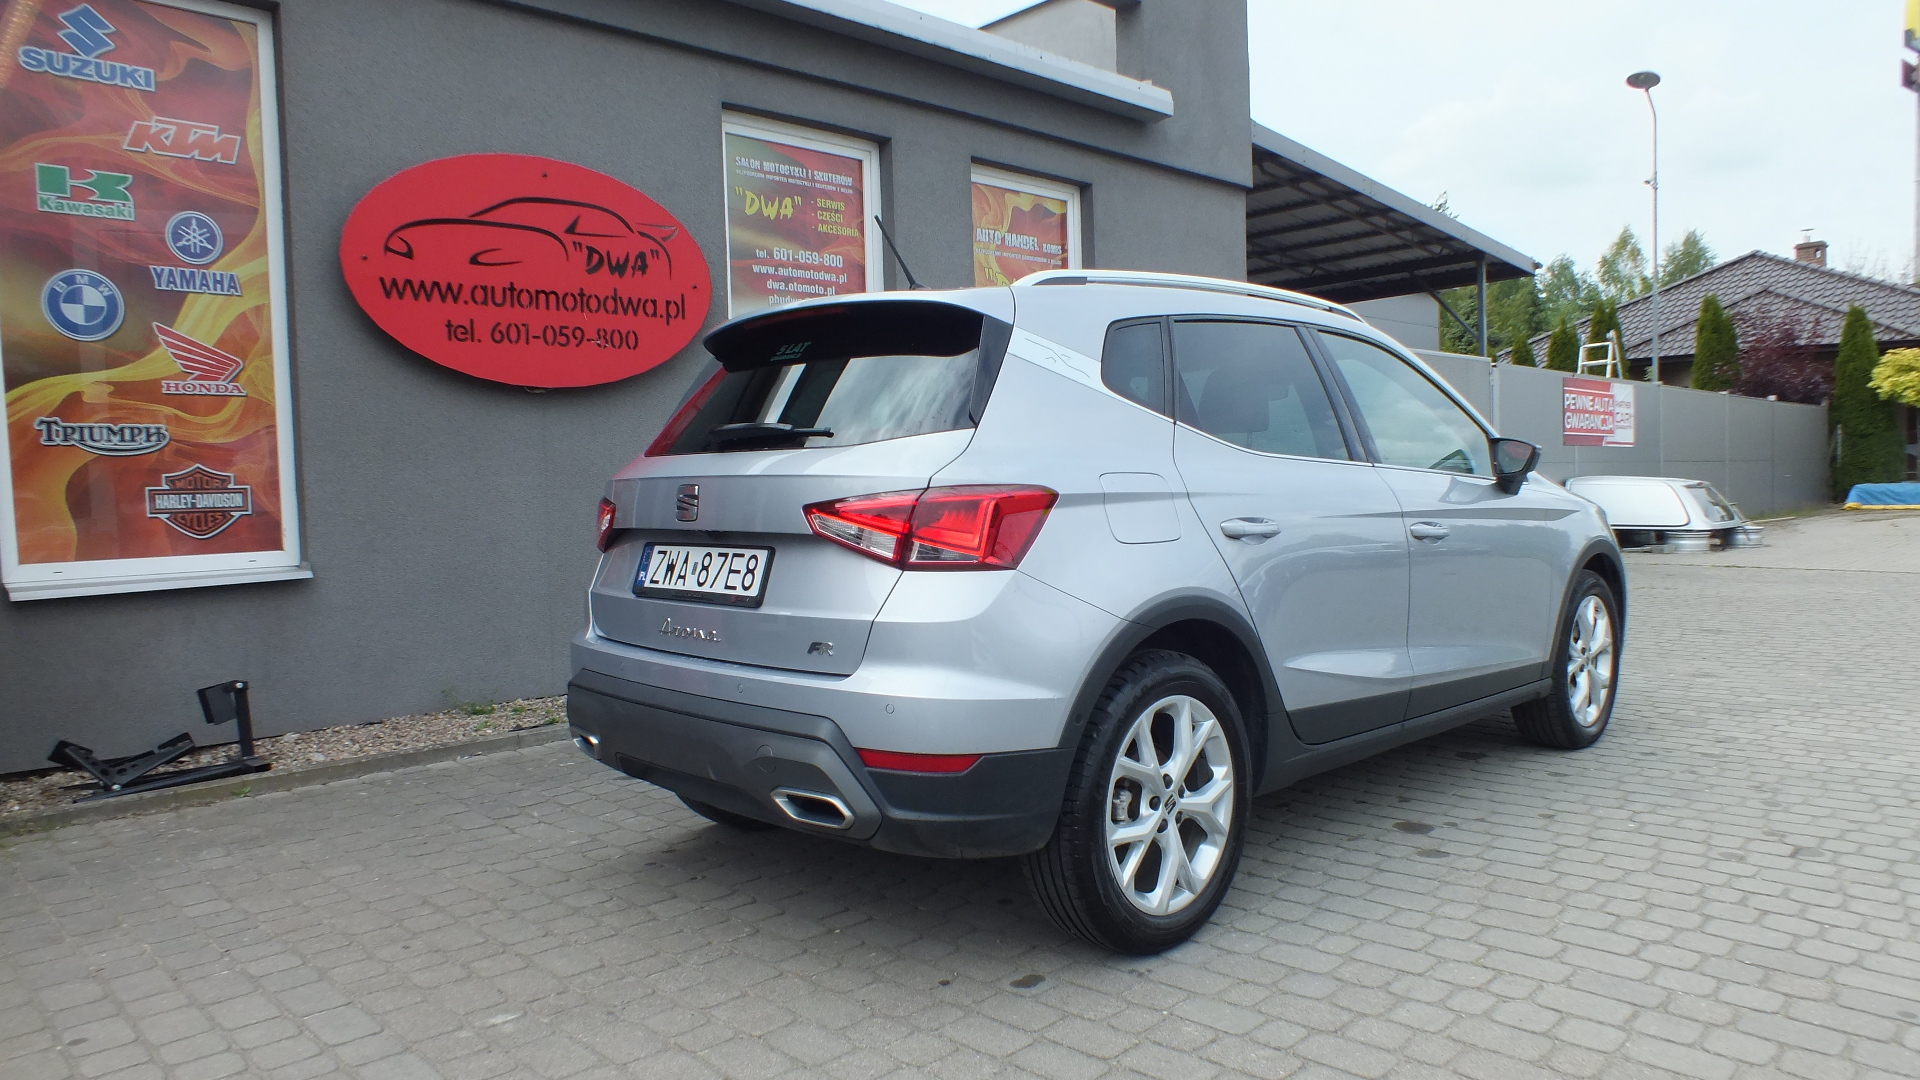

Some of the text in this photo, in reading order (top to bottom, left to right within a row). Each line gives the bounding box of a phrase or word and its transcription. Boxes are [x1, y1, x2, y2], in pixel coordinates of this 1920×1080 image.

[18, 46, 155, 92] SUZUKI
[123, 116, 241, 165] KTM
[736, 156, 761, 170] SALON
[814, 172, 852, 187] SKUTERÓW
[38, 196, 135, 221] Kawasaki
[735, 187, 802, 220] "DWA"
[817, 199, 845, 211] SERWIS
[818, 209, 843, 223] CZĘŚCI
[818, 225, 859, 237] AKCESORIA
[976, 228, 1002, 246] AUTO
[1004, 232, 1039, 251] HANDEL
[572, 241, 660, 279] "DWA"
[756, 248, 843, 268] tel. 601-059-800
[53, 275, 113, 297] BMW
[150, 266, 242, 296] YAMAHA
[752, 264, 847, 284] www.automotodwa.pl
[767, 279, 836, 297] dwa.otomoto.pl
[379, 276, 686, 327] www.automotodwa.pl
[445, 319, 639, 351] tel. 601-059-800
[162, 381, 246, 395] HONDA
[1564, 393, 1593, 411] PEWNE
[1594, 396, 1614, 412] AUTA
[36, 418, 169, 453] TRIUMPH
[155, 492, 243, 510] HARLEY-DAVIDSON
[649, 550, 759, 592] ZWA 87E8
[658, 617, 721, 642] Arona
[807, 641, 834, 656] FR
